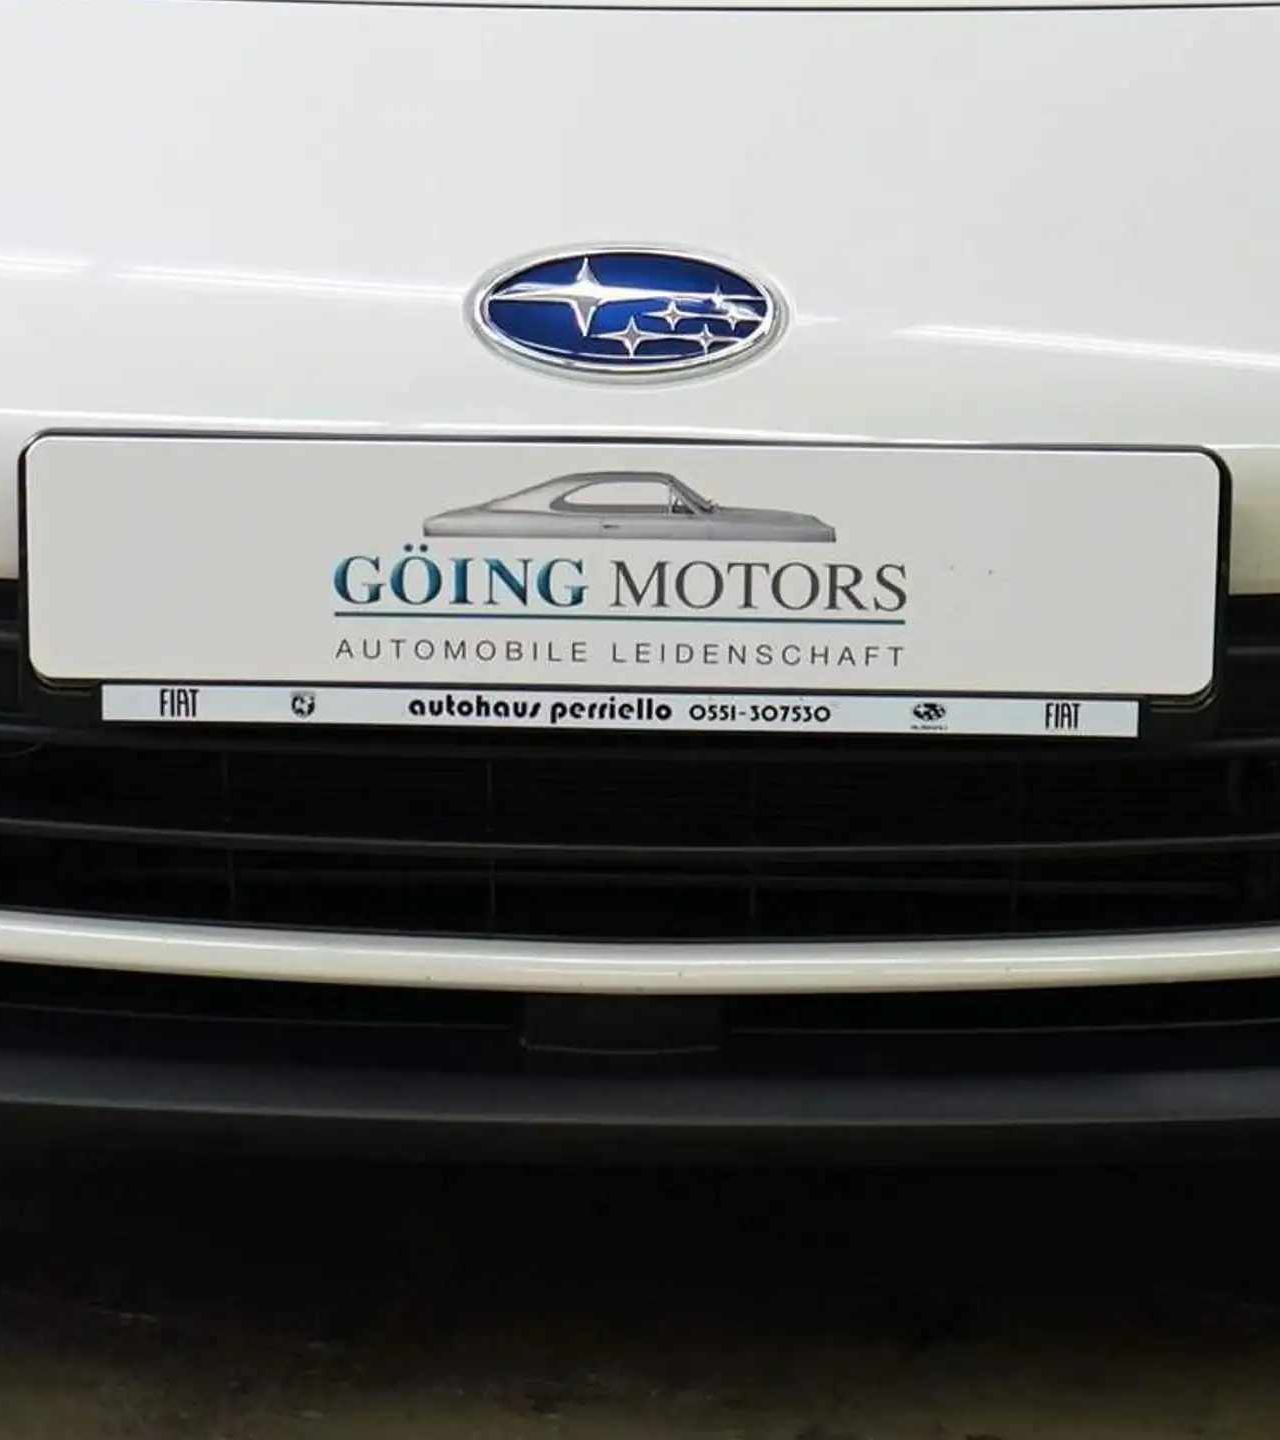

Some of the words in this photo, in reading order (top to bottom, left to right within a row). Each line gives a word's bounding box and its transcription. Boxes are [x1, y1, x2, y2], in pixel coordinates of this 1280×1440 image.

[334, 544, 588, 607] GÖING
[611, 561, 907, 612] MOTORS
[335, 638, 587, 663] AUTOMOBILE
[612, 643, 905, 667] LEIDENSCHAFT
[160, 689, 199, 718] FIAT
[409, 695, 541, 719] autohaus
[551, 697, 672, 724] perriello
[689, 704, 831, 723] 0551-307530
[1045, 703, 1081, 730] FIAT
